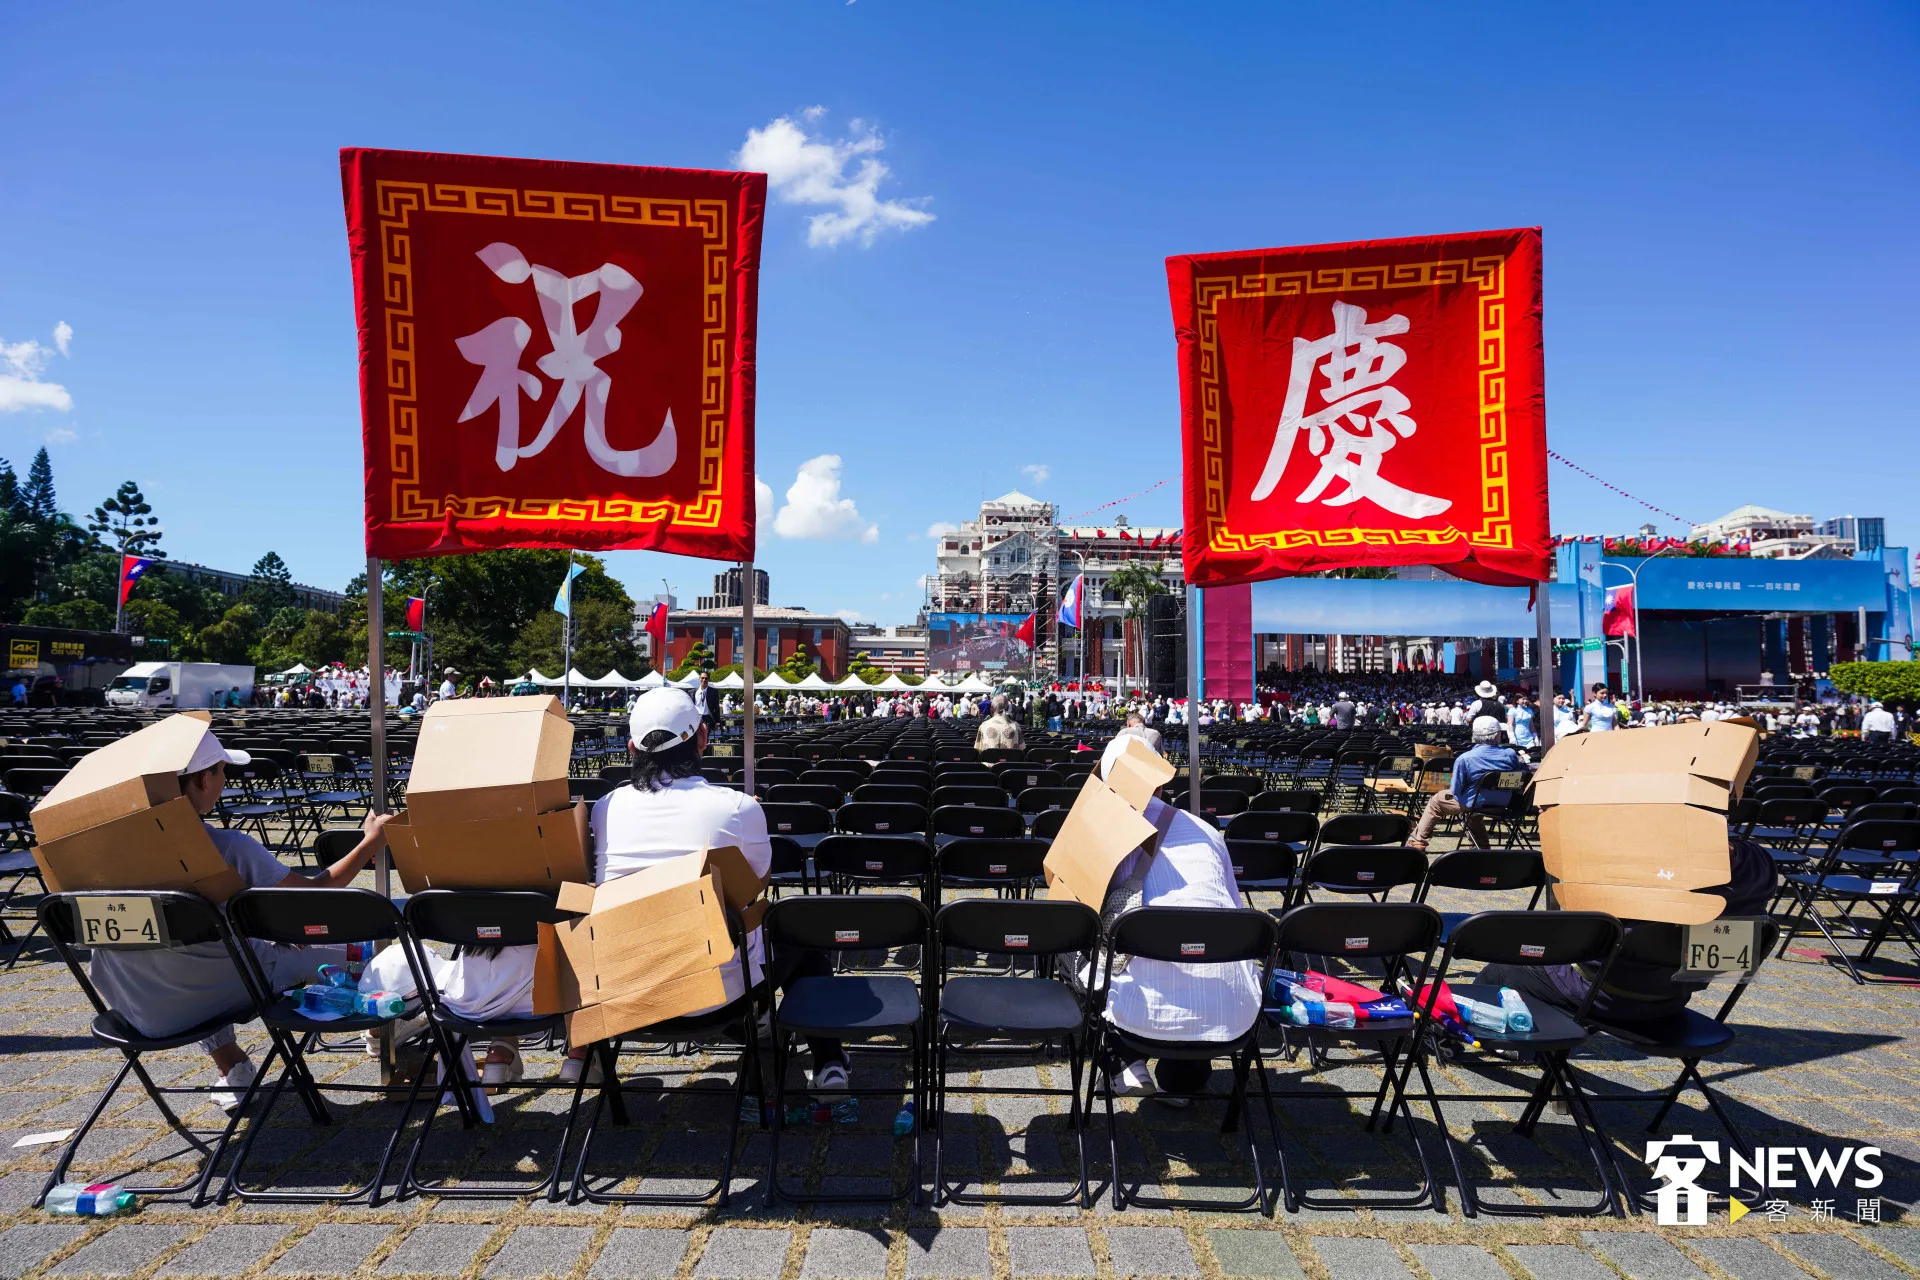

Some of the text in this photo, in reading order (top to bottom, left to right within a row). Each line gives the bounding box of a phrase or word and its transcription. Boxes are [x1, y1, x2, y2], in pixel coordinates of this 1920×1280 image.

[454, 241, 678, 478] 祝
[1250, 299, 1453, 520] 慶
[13, 643, 37, 653] 4K
[12, 656, 36, 666] HDR
[310, 763, 334, 772] F6-3
[106, 903, 127, 913] 南廣
[84, 917, 158, 942] F6-4
[1713, 924, 1731, 935] 南廣
[1689, 943, 1750, 969] F6-4
